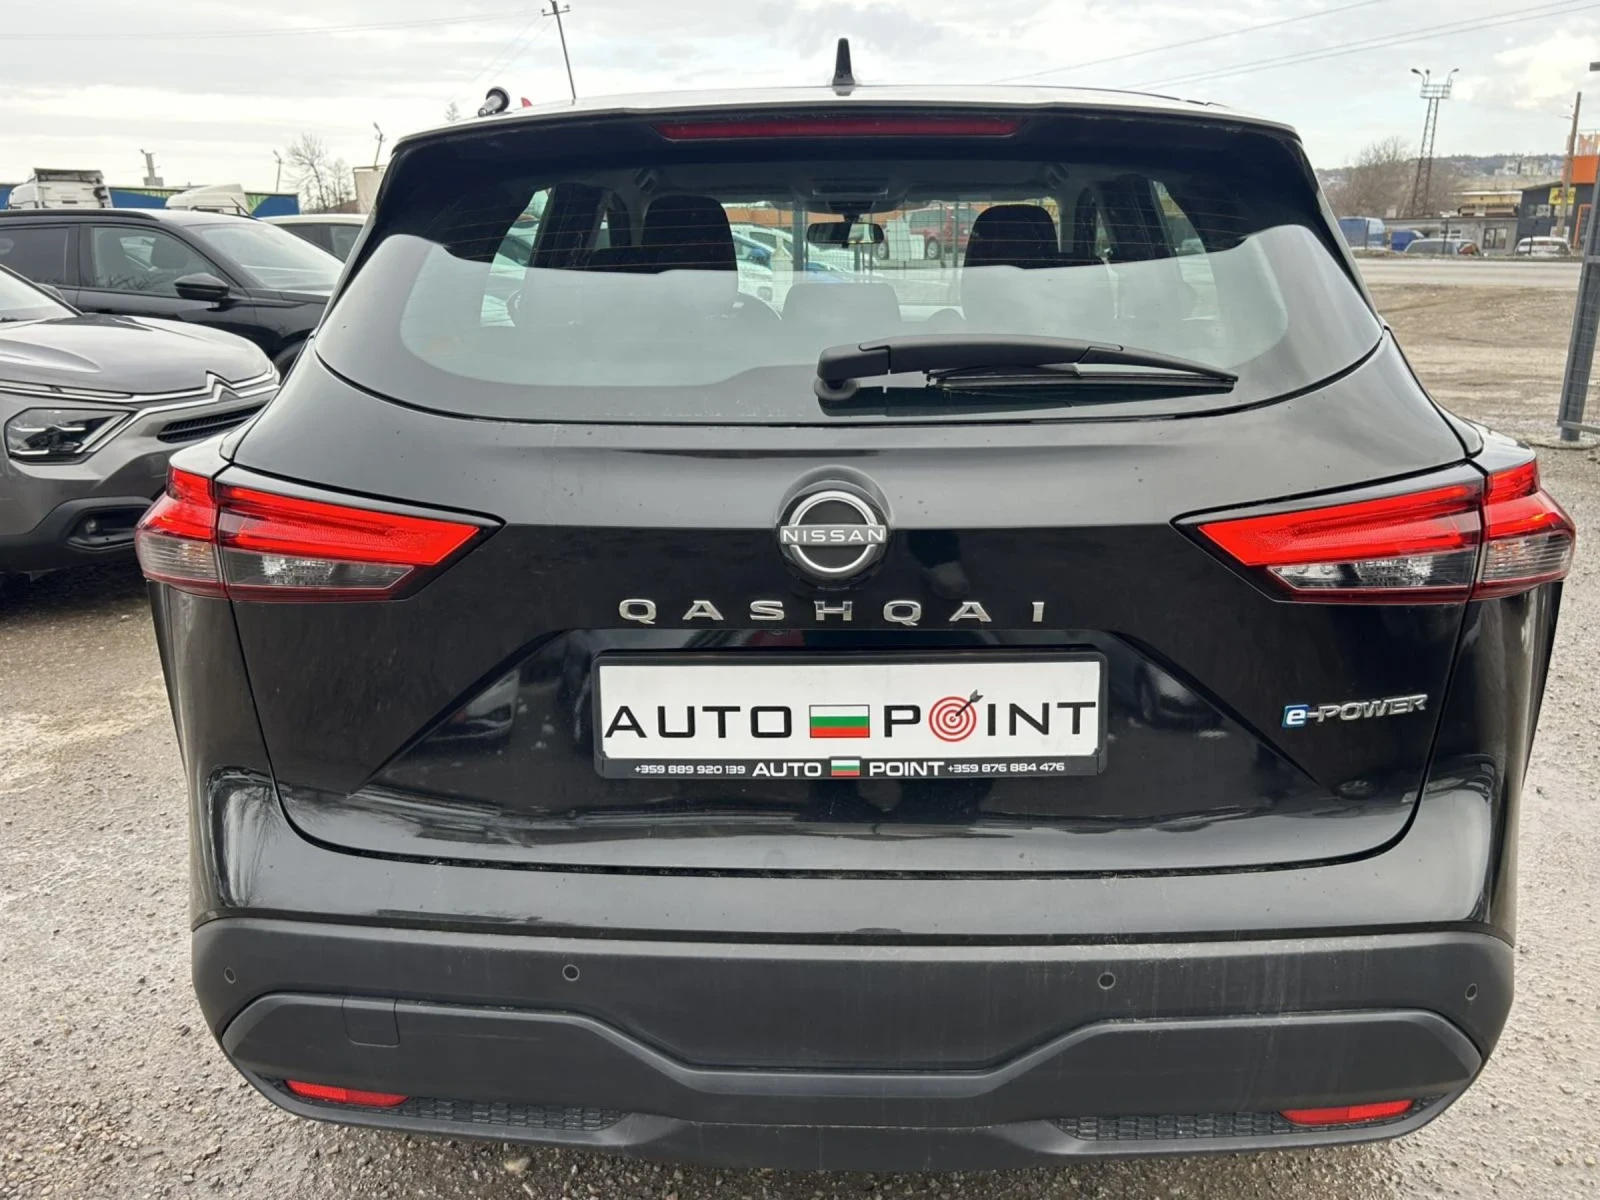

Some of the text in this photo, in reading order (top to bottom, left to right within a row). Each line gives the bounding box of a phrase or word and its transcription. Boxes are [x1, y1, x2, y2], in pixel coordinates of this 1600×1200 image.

[783, 528, 884, 542] NISSAN
[618, 598, 1046, 626] QASHQAI
[1283, 694, 1428, 726] e-POWER
[604, 705, 793, 738] AUTO
[634, 764, 746, 775] +359 889 920 139
[752, 761, 945, 777] AUTO POINT
[947, 762, 1065, 773] +359 876 884 476
